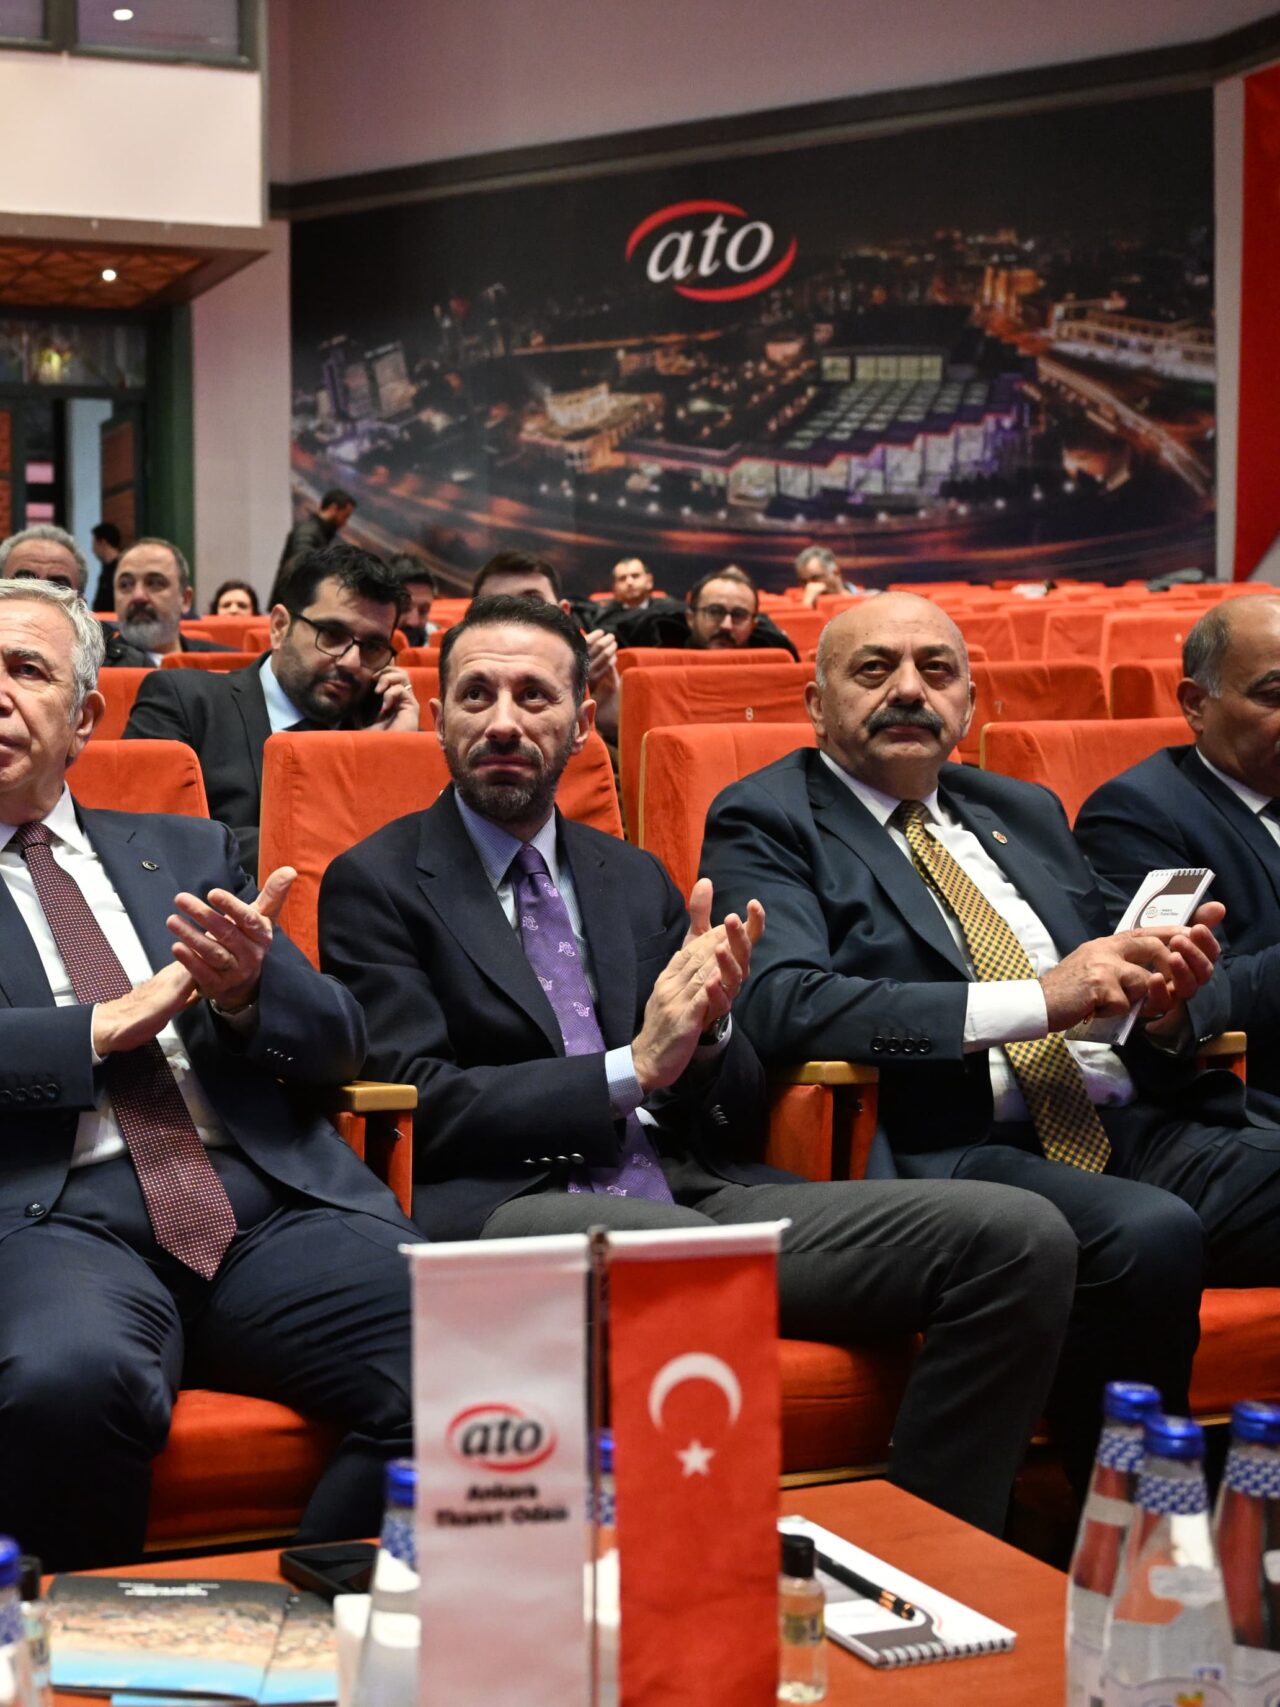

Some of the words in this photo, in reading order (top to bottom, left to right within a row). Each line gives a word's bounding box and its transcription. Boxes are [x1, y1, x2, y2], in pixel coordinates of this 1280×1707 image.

[646, 213, 774, 283] ato
[746, 706, 754, 721] 8
[461, 1418, 543, 1456] ato
